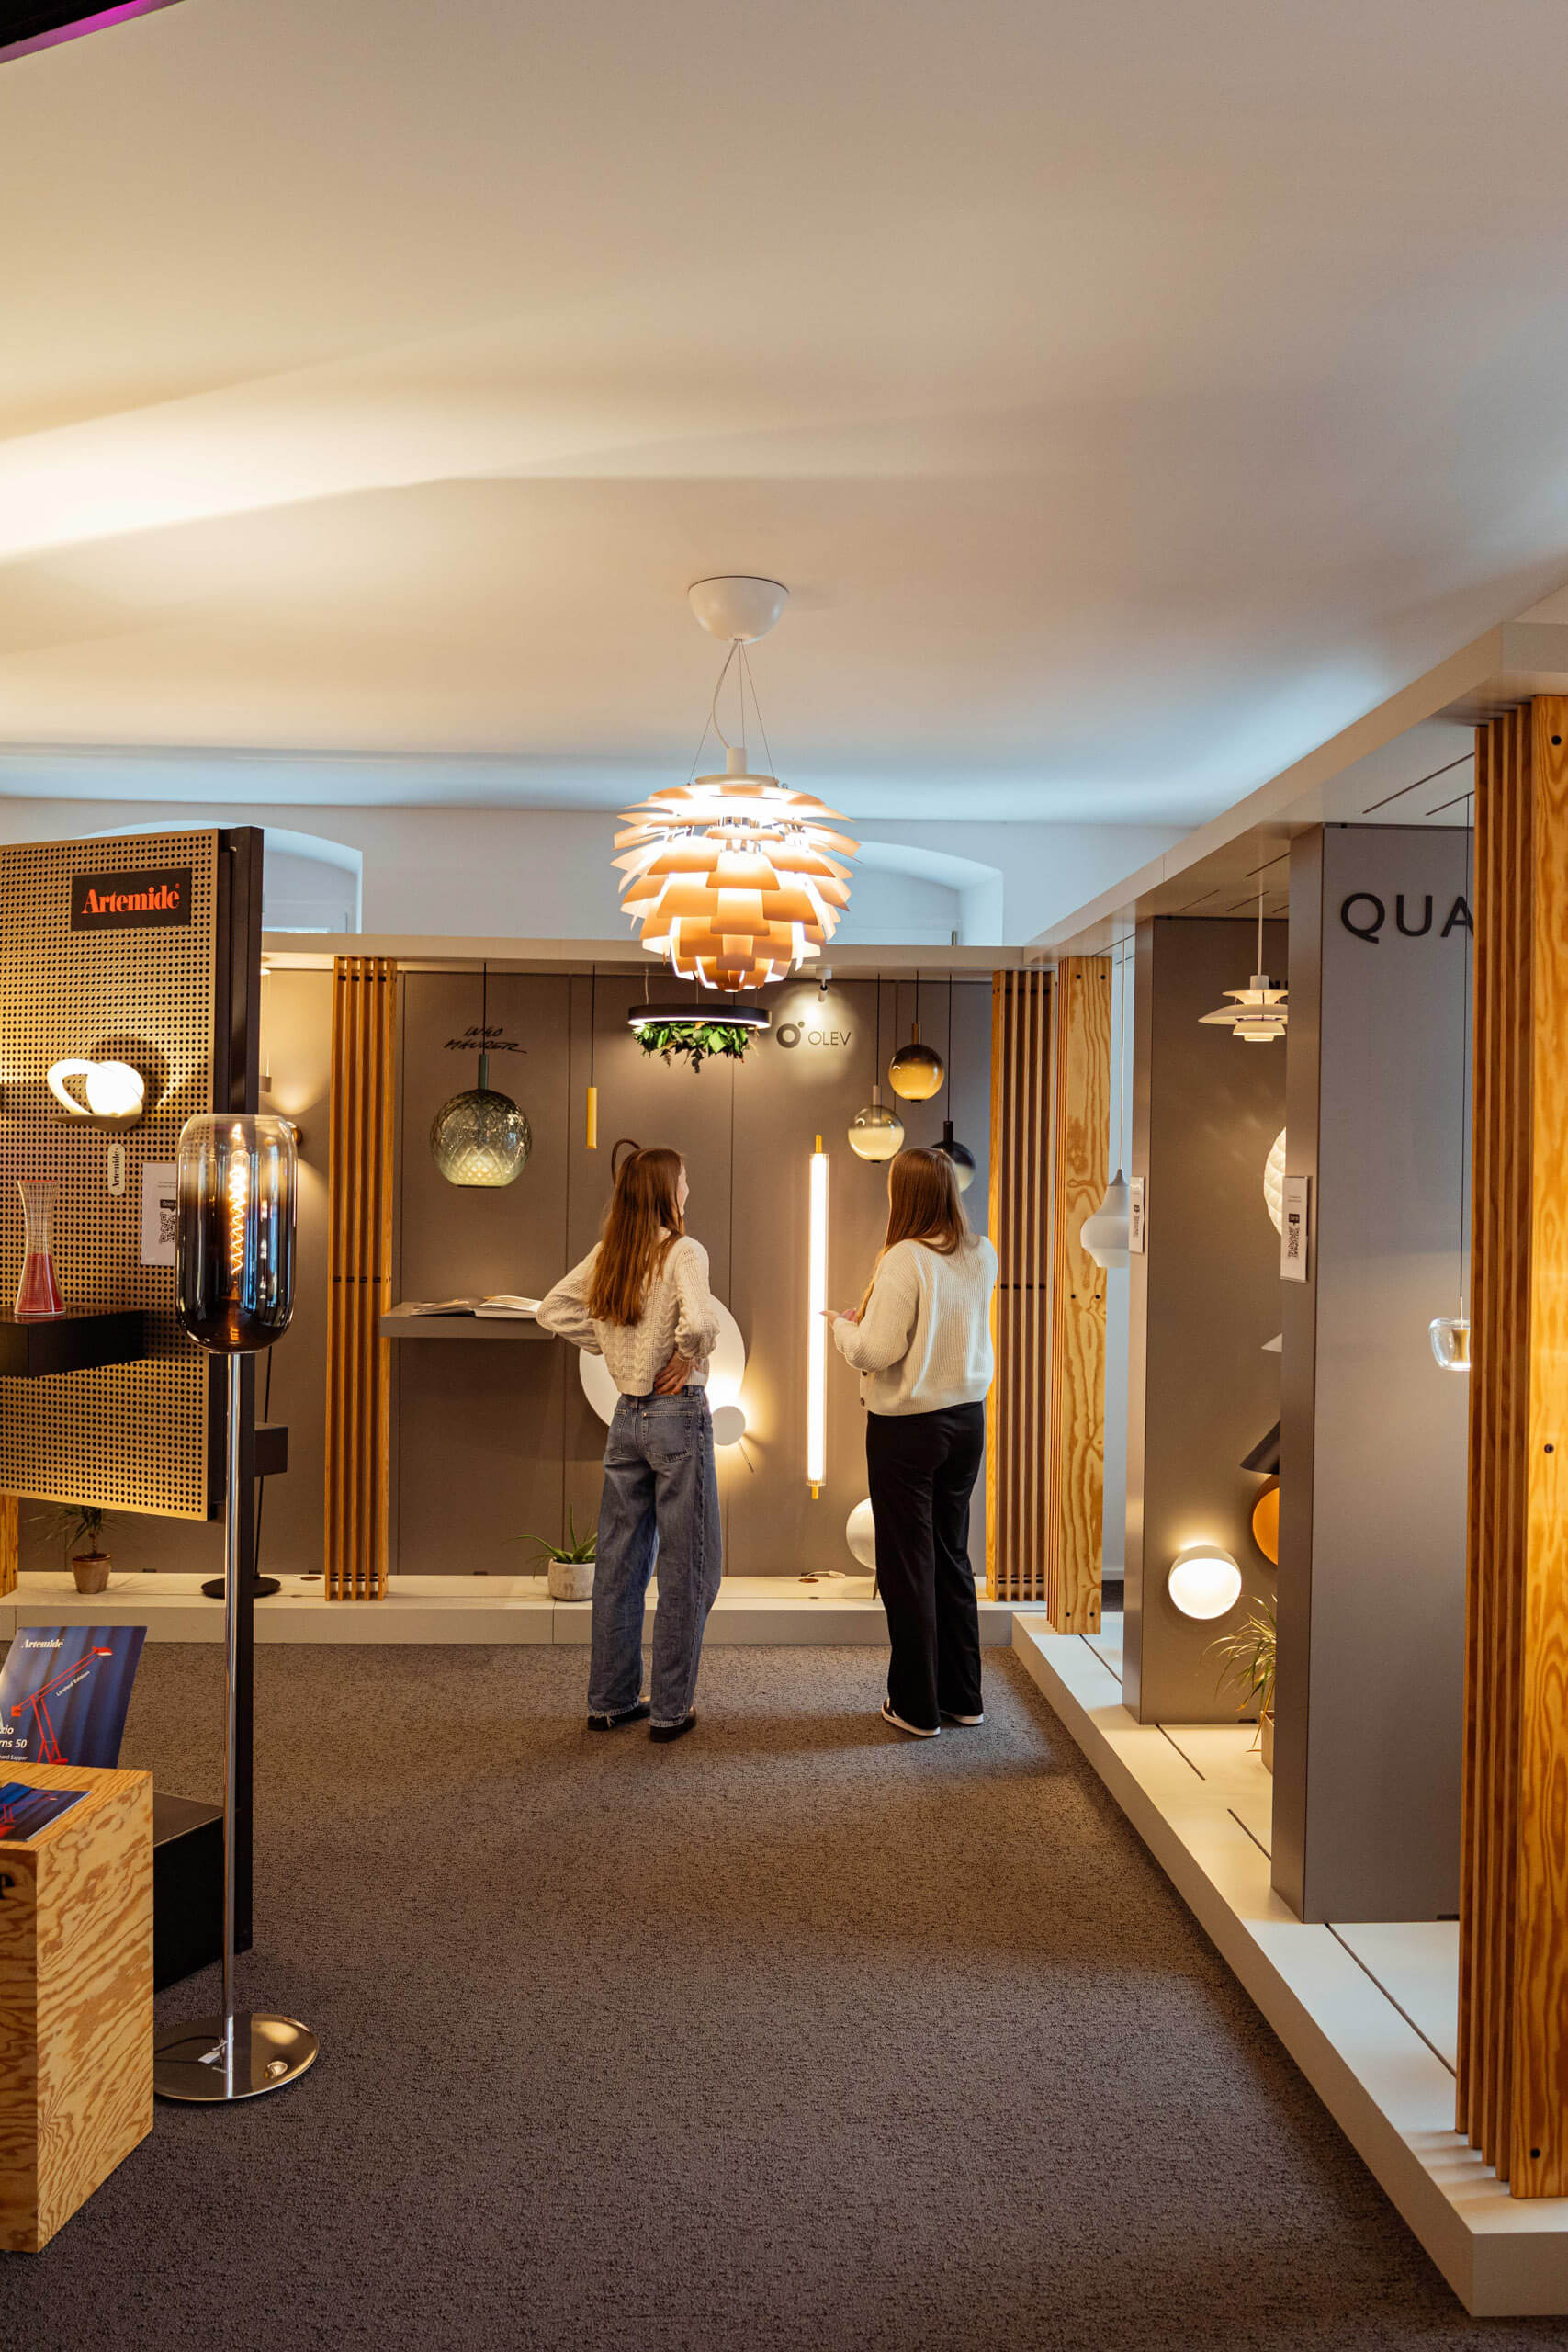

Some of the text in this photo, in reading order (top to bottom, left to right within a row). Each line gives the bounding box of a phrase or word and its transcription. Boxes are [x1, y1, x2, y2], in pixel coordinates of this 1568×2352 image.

[81, 884, 181, 914] Artemide
[1341, 892, 1473, 944] QUA
[808, 1031, 852, 1046] OLEV
[20, 1639, 64, 1648] Artemide
[15, 1739, 28, 1749] 50
